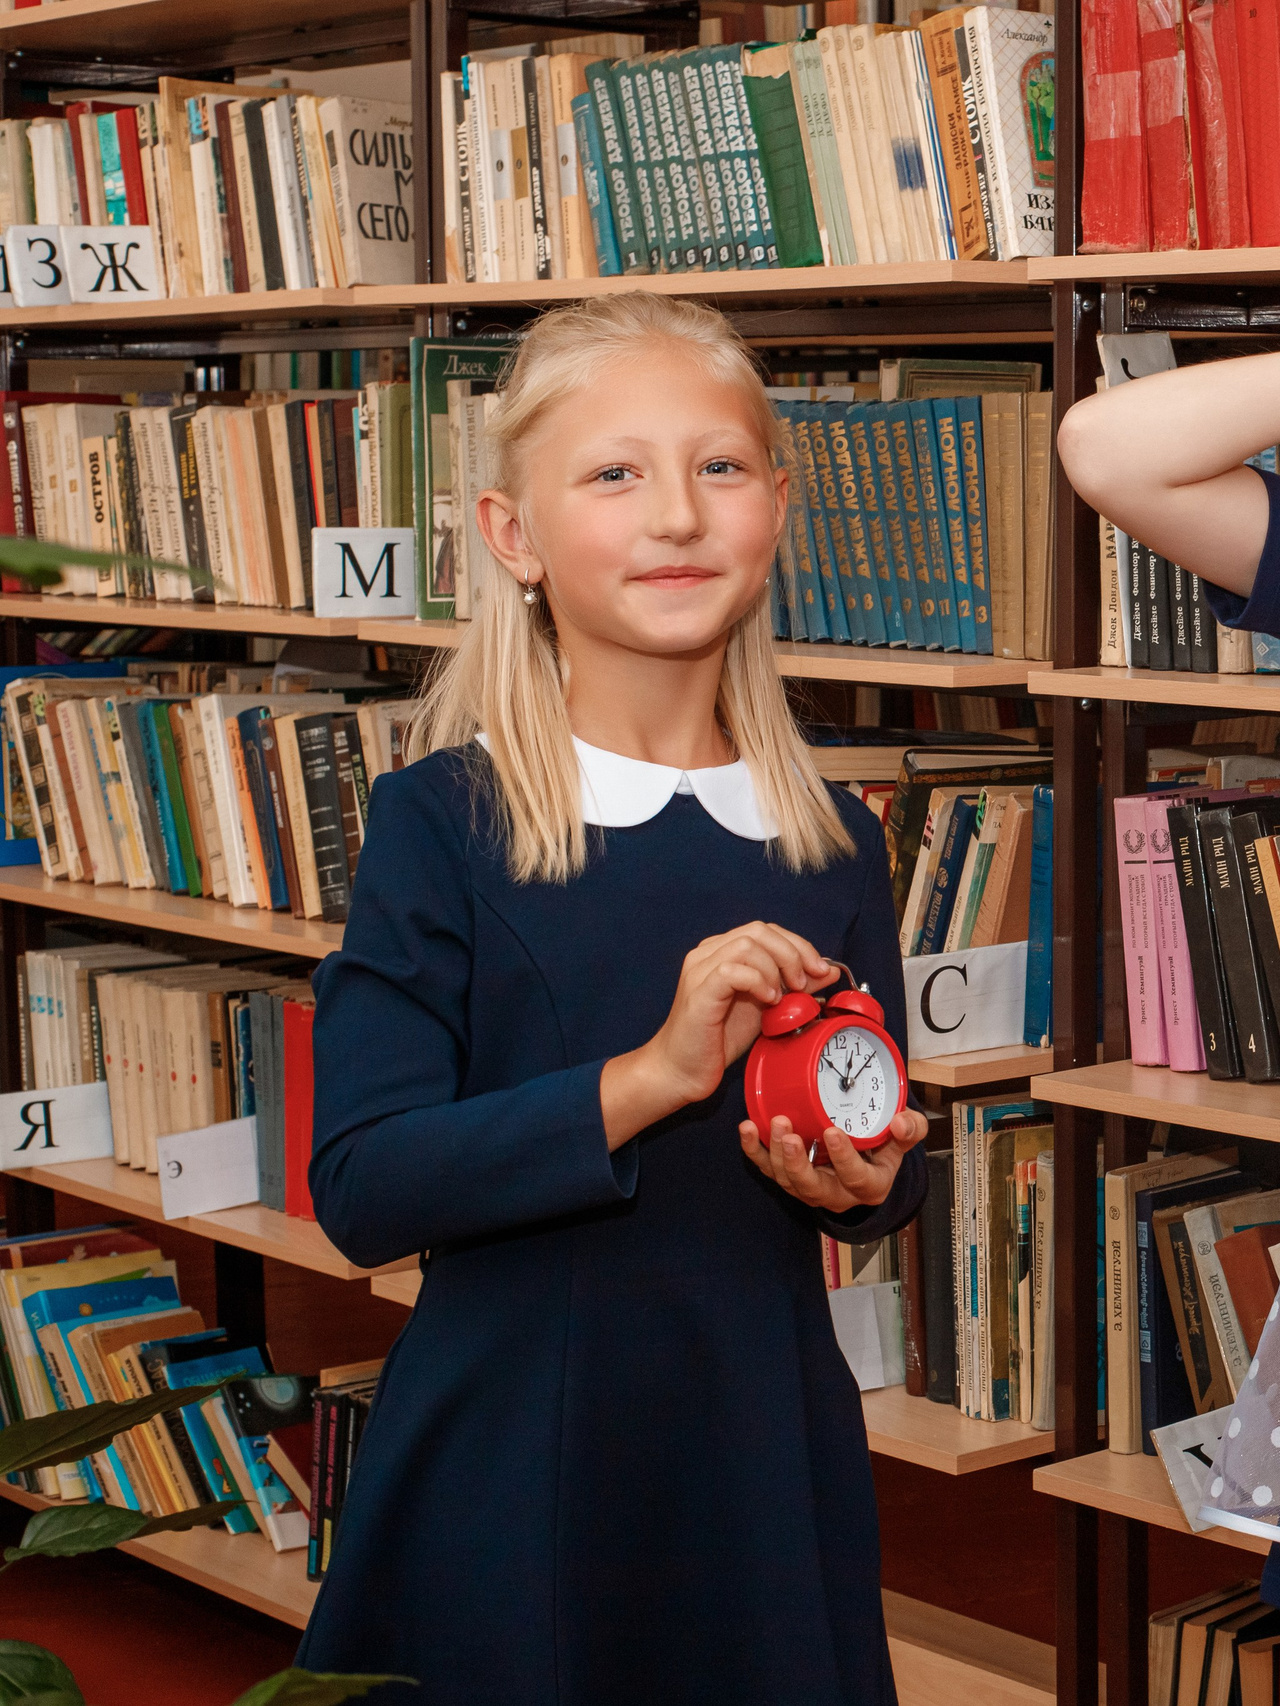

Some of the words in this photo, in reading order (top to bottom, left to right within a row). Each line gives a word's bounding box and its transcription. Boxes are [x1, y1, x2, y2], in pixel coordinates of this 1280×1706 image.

[1001, 28, 1048, 46] Александр
[803, 95, 814, 126] ДЕФО
[820, 93, 830, 124] ДЕФО
[950, 76, 964, 120] ХОЛМСЕ
[961, 75, 981, 145] СТОИК
[456, 120, 471, 182] СТОИК
[947, 113, 963, 170] ЗАПИСКИ
[531, 167, 544, 218] ДРАЙЗЕР
[612, 168, 634, 242] ТЕОДОР
[635, 167, 656, 241] ТЕОДОР
[653, 167, 676, 244] ТЕОДОР
[670, 163, 693, 240] ТЕОДОР
[703, 161, 726, 238] ТЕОДОР
[734, 158, 757, 237] ТЕОДОР
[978, 173, 991, 220] ДРАЙЗЕР
[357, 203, 409, 242] СЕГО
[985, 222, 997, 255] Теодор
[27, 237, 63, 289] З
[80, 241, 149, 292] Ж
[535, 223, 547, 271] ТЕОДОР
[629, 252, 637, 265] 1
[686, 249, 696, 264] 6
[719, 245, 729, 260] 8
[750, 245, 763, 261] 10
[443, 354, 487, 376] Джек
[810, 420, 838, 509] ЛОНДОН
[829, 420, 859, 509] ЛОНДОН
[892, 421, 919, 512] ЛОНДОН
[939, 417, 960, 509] ЛОНДОН
[961, 421, 981, 516] ЛОНДОН
[88, 451, 105, 523] ОСТРОВ
[849, 514, 871, 579] ДЖЕК
[909, 517, 929, 583] ДЖЕК
[950, 517, 967, 584] ДЖЕК
[972, 521, 985, 590] ДЖЕК
[335, 542, 401, 598] М
[1108, 570, 1118, 612] Лондон
[1131, 552, 1141, 596] Фенимор
[1148, 555, 1157, 599] Фенимор
[864, 594, 873, 610] 8
[1133, 602, 1142, 640] Джеймс
[1107, 618, 1117, 649] Джек
[1150, 605, 1160, 644] Джеймс
[1176, 606, 1185, 645] Джеймс
[1179, 836, 1191, 855] РИД
[1212, 836, 1225, 857] РИД
[1182, 859, 1195, 887] МАЙН
[1216, 860, 1230, 888] МАЙН
[1137, 956, 1146, 995] Хемингуэй
[921, 963, 968, 1034] С
[1139, 1000, 1147, 1025] Эрнест
[833, 1035, 847, 1050] 12
[855, 1042, 861, 1056] 1
[864, 1054, 871, 1068] 2
[1209, 1032, 1216, 1051] 3
[1248, 1033, 1256, 1052] 4
[868, 1097, 876, 1111] 4
[871, 1077, 879, 1091] 3
[13, 1099, 60, 1151] Я
[844, 1118, 852, 1132] 6
[861, 1111, 868, 1126] 5
[167, 1160, 183, 1179] Э
[1111, 1240, 1122, 1318] ХЕМИНГУЭЙ
[1175, 1240, 1195, 1299] Хемингуэй
[1209, 1274, 1240, 1353] ХЕМИНГУЭЙ
